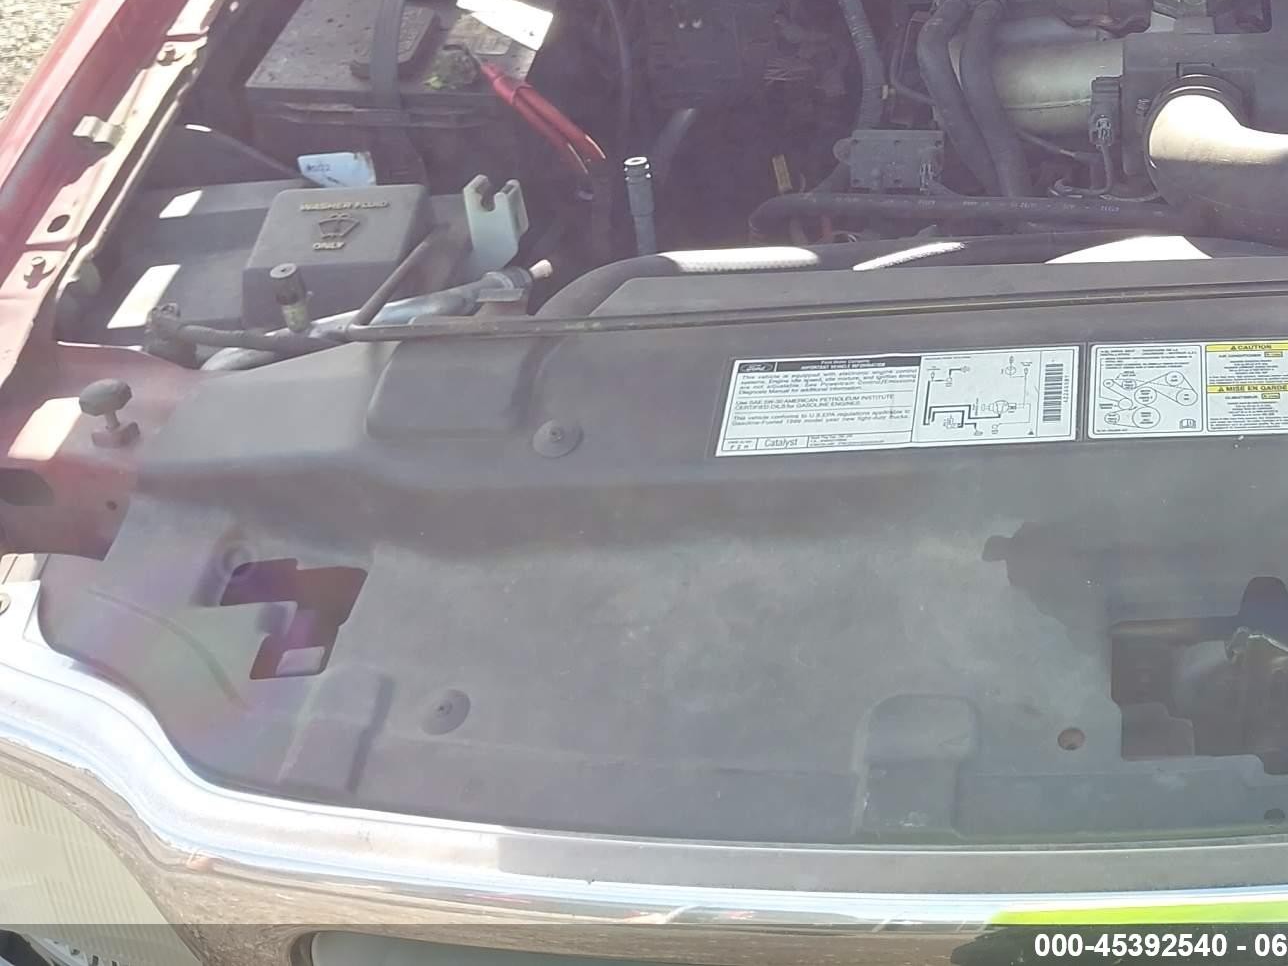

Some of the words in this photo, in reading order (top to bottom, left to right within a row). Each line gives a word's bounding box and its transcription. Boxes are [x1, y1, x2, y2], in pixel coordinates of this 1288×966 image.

[300, 202, 352, 211] WASHER
[354, 201, 390, 210] FLUID
[312, 241, 345, 250] ONLY
[764, 439, 798, 449] Catalyst
